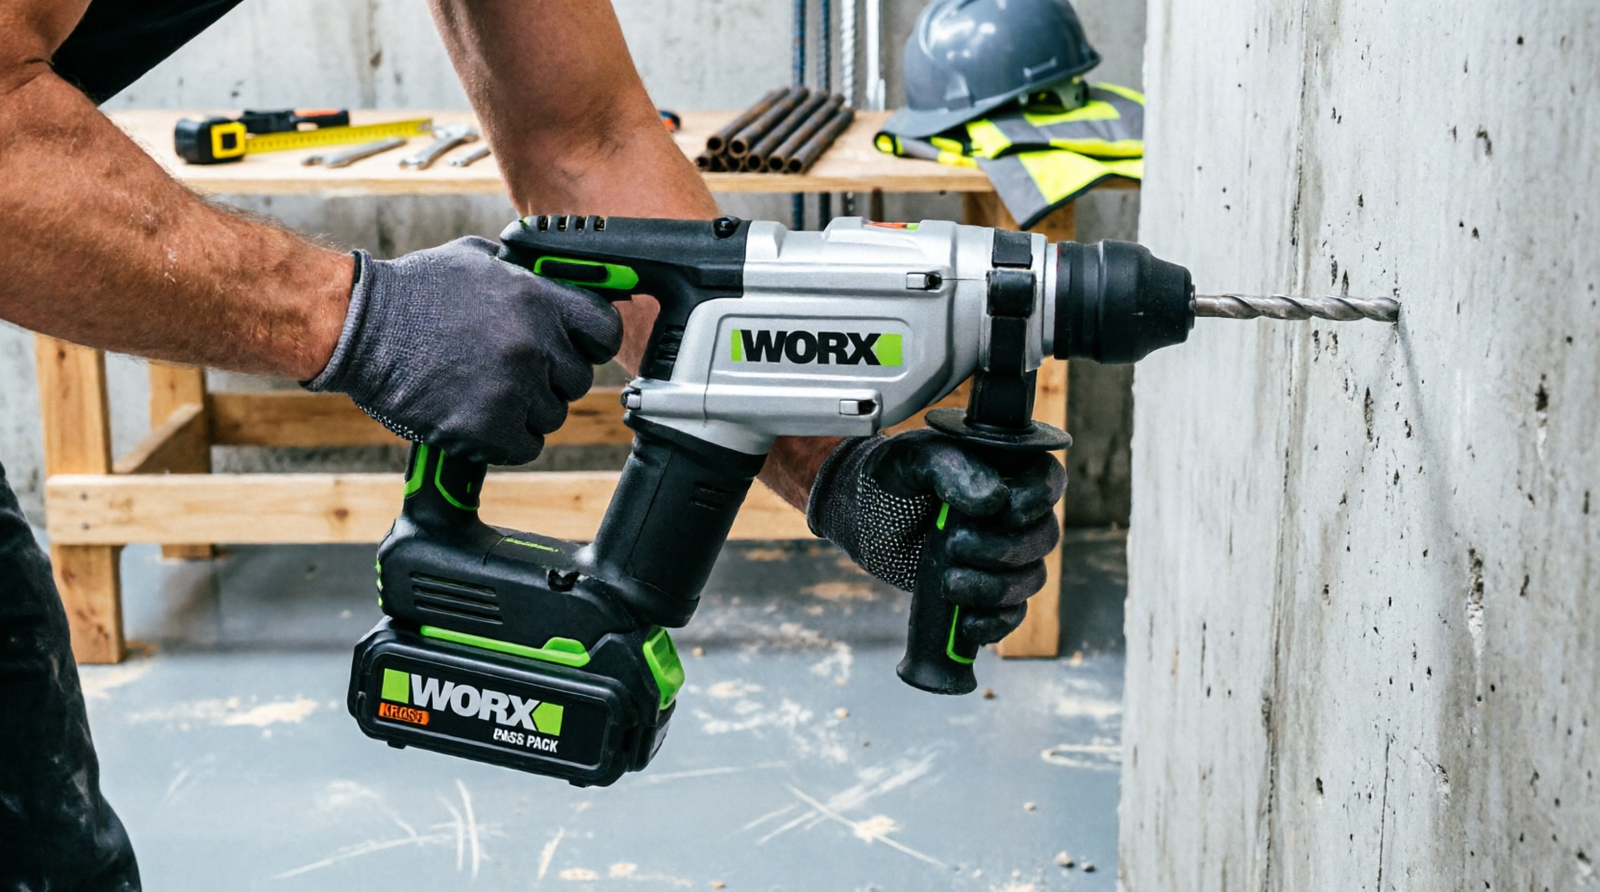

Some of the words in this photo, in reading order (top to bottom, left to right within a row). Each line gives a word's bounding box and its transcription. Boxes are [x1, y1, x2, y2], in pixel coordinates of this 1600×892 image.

[741, 329, 881, 366] WORX
[410, 673, 541, 732] WORX
[526, 734, 559, 754] PACK
